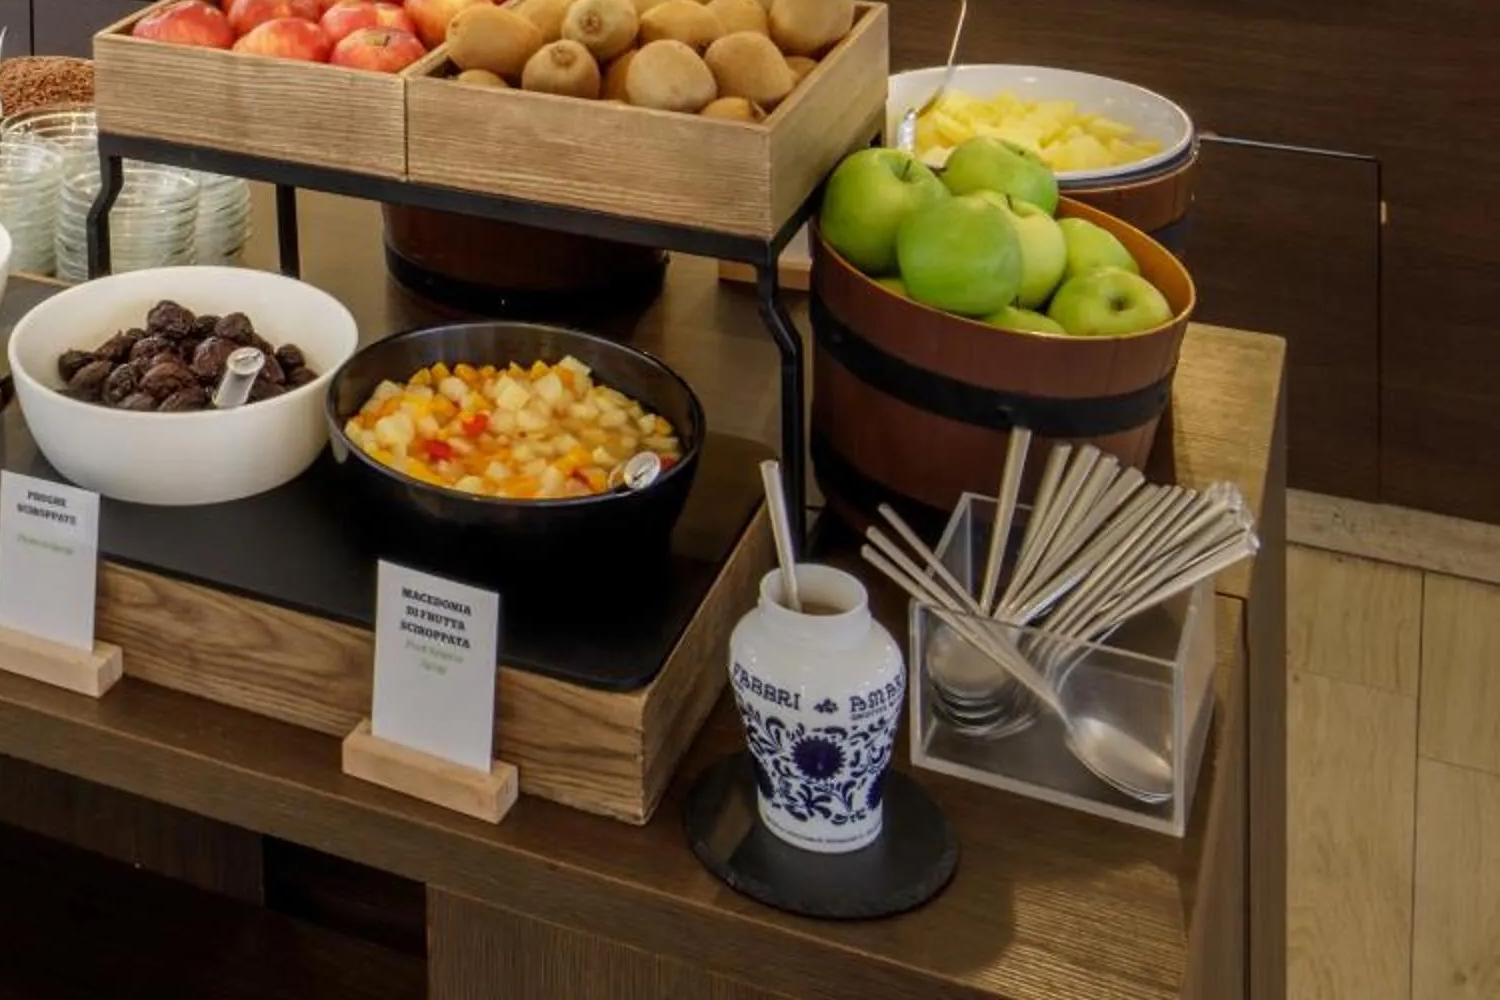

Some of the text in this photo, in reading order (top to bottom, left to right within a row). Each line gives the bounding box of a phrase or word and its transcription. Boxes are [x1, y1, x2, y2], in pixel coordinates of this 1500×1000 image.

[401, 586, 472, 616] MACEDONIA
[405, 604, 466, 631] DI FRUTTA
[400, 619, 471, 649] SCIROPPATA
